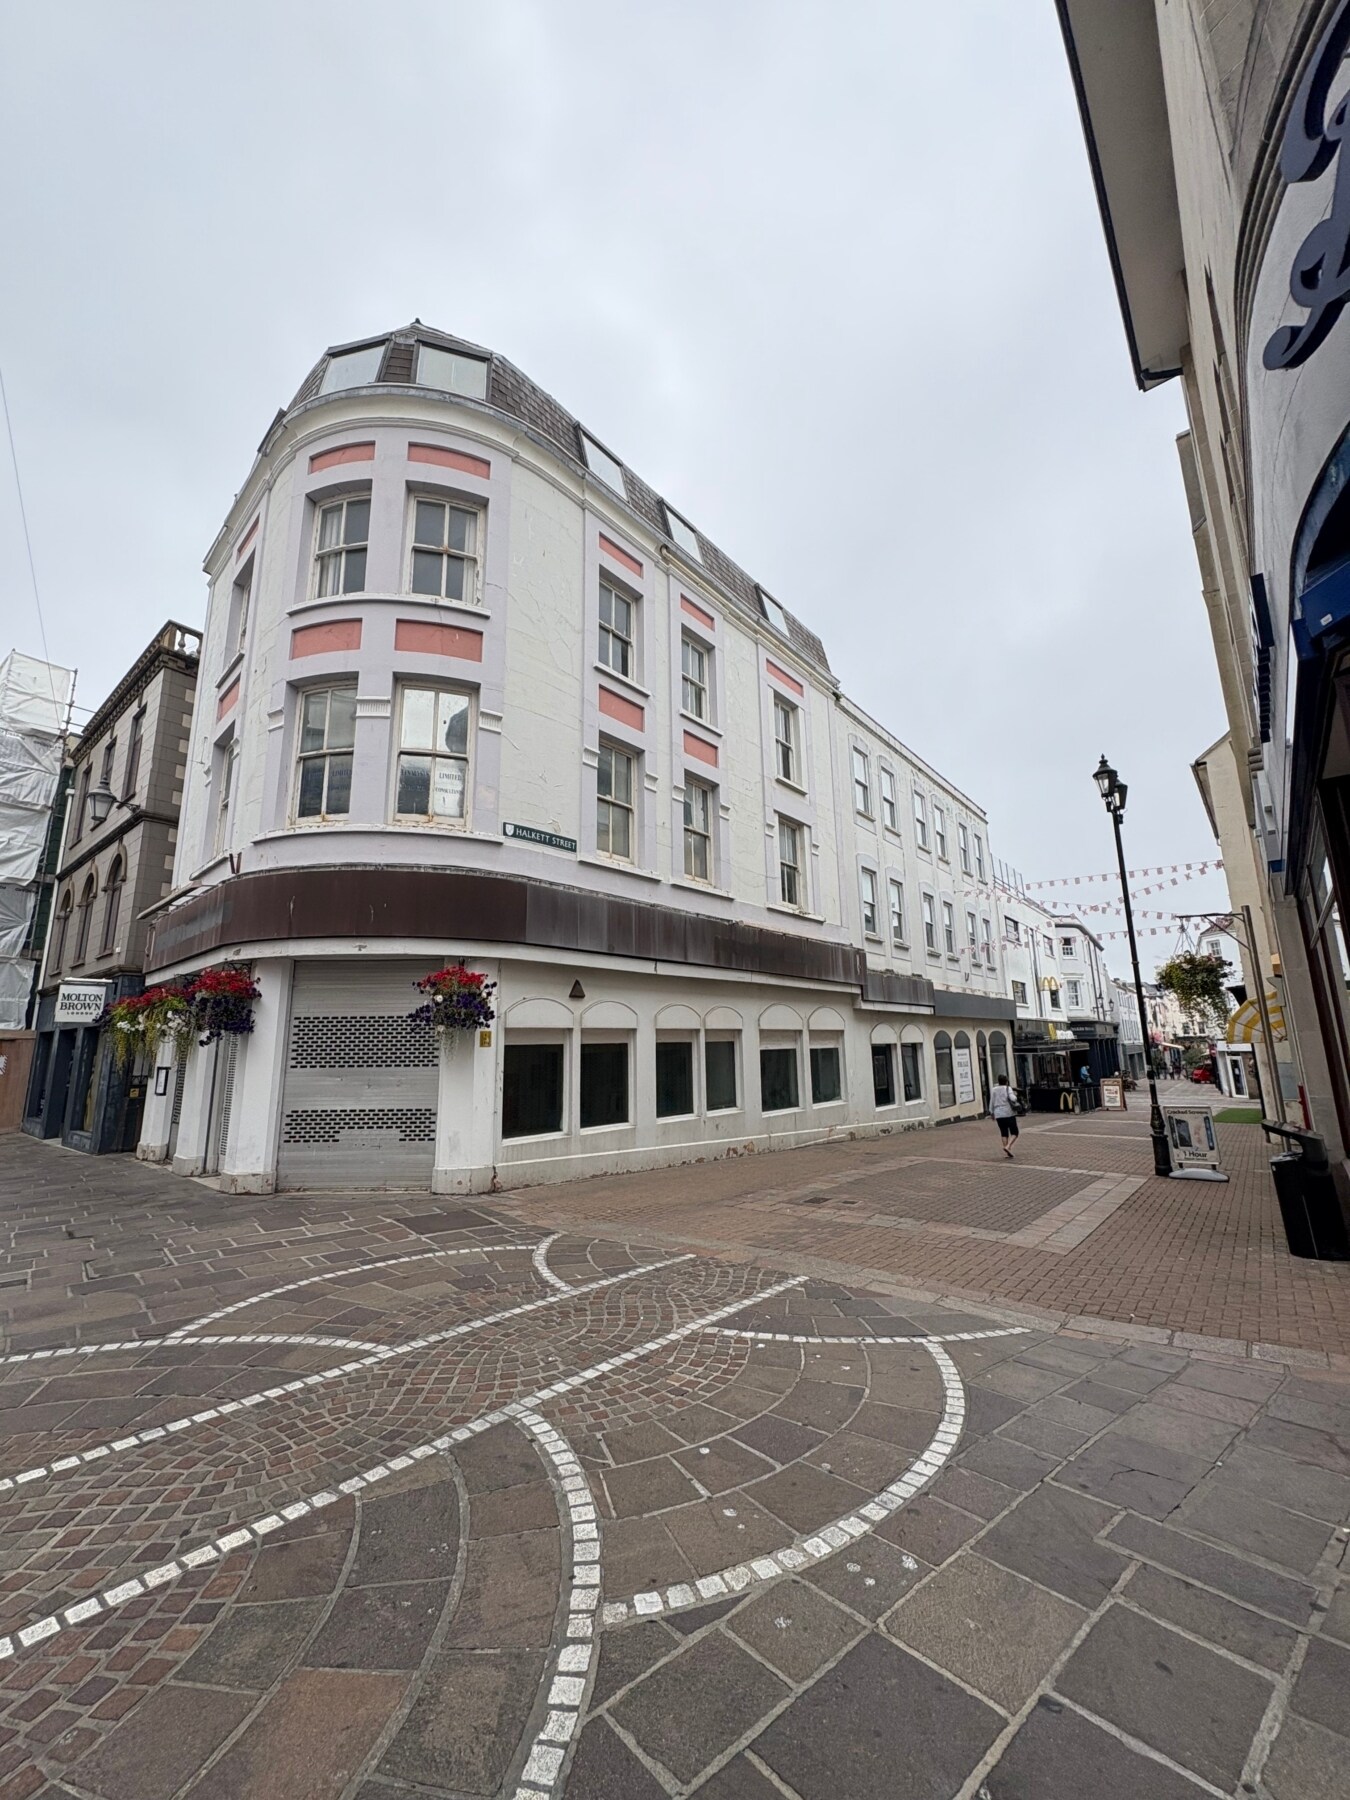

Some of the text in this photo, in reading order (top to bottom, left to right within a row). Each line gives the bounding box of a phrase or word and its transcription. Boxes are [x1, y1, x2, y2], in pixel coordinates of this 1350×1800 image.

[516, 827, 576, 850] HALKETT STREET
[61, 992, 103, 1002] MOLTON
[60, 1002, 102, 1011] BROWN
[1188, 1150, 1208, 1158] Hour
